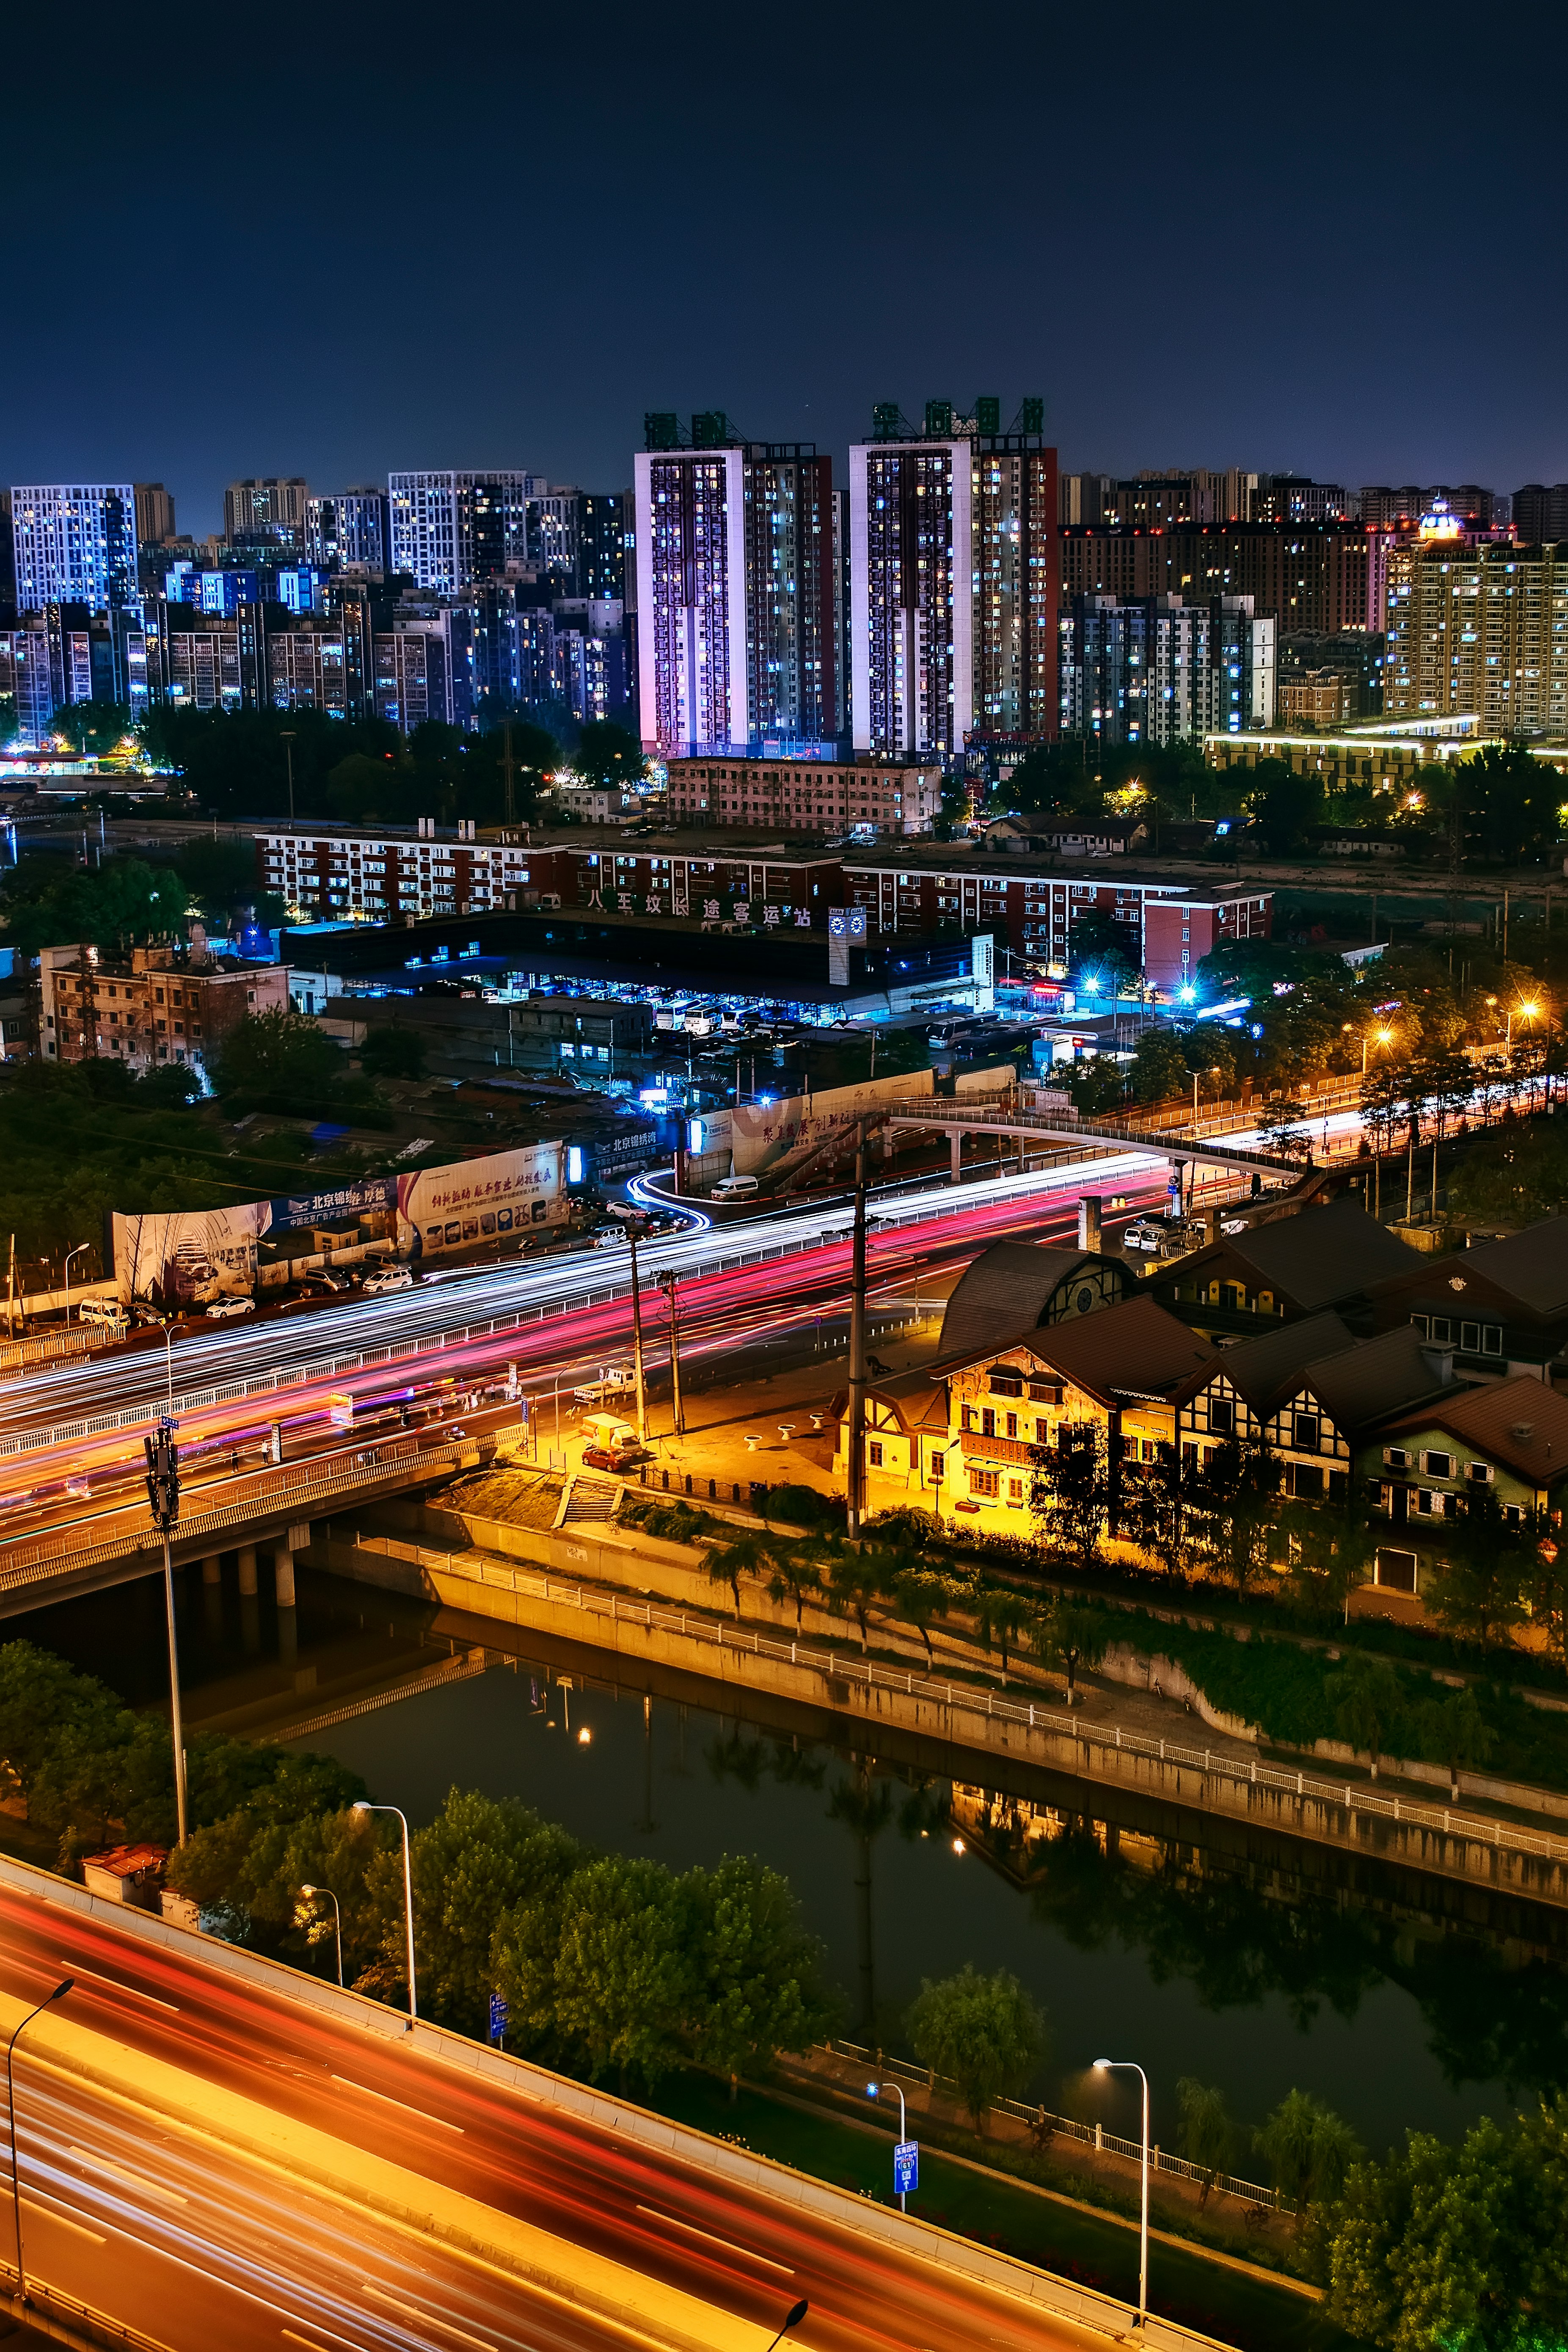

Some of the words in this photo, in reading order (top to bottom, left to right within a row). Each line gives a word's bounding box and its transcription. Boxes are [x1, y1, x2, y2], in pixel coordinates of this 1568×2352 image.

[588, 889, 811, 926] 八王坟长途客运站
[613, 1131, 656, 1151] 北京锦绣湾
[596, 1147, 656, 1166] 中国北京广告产业园区三期
